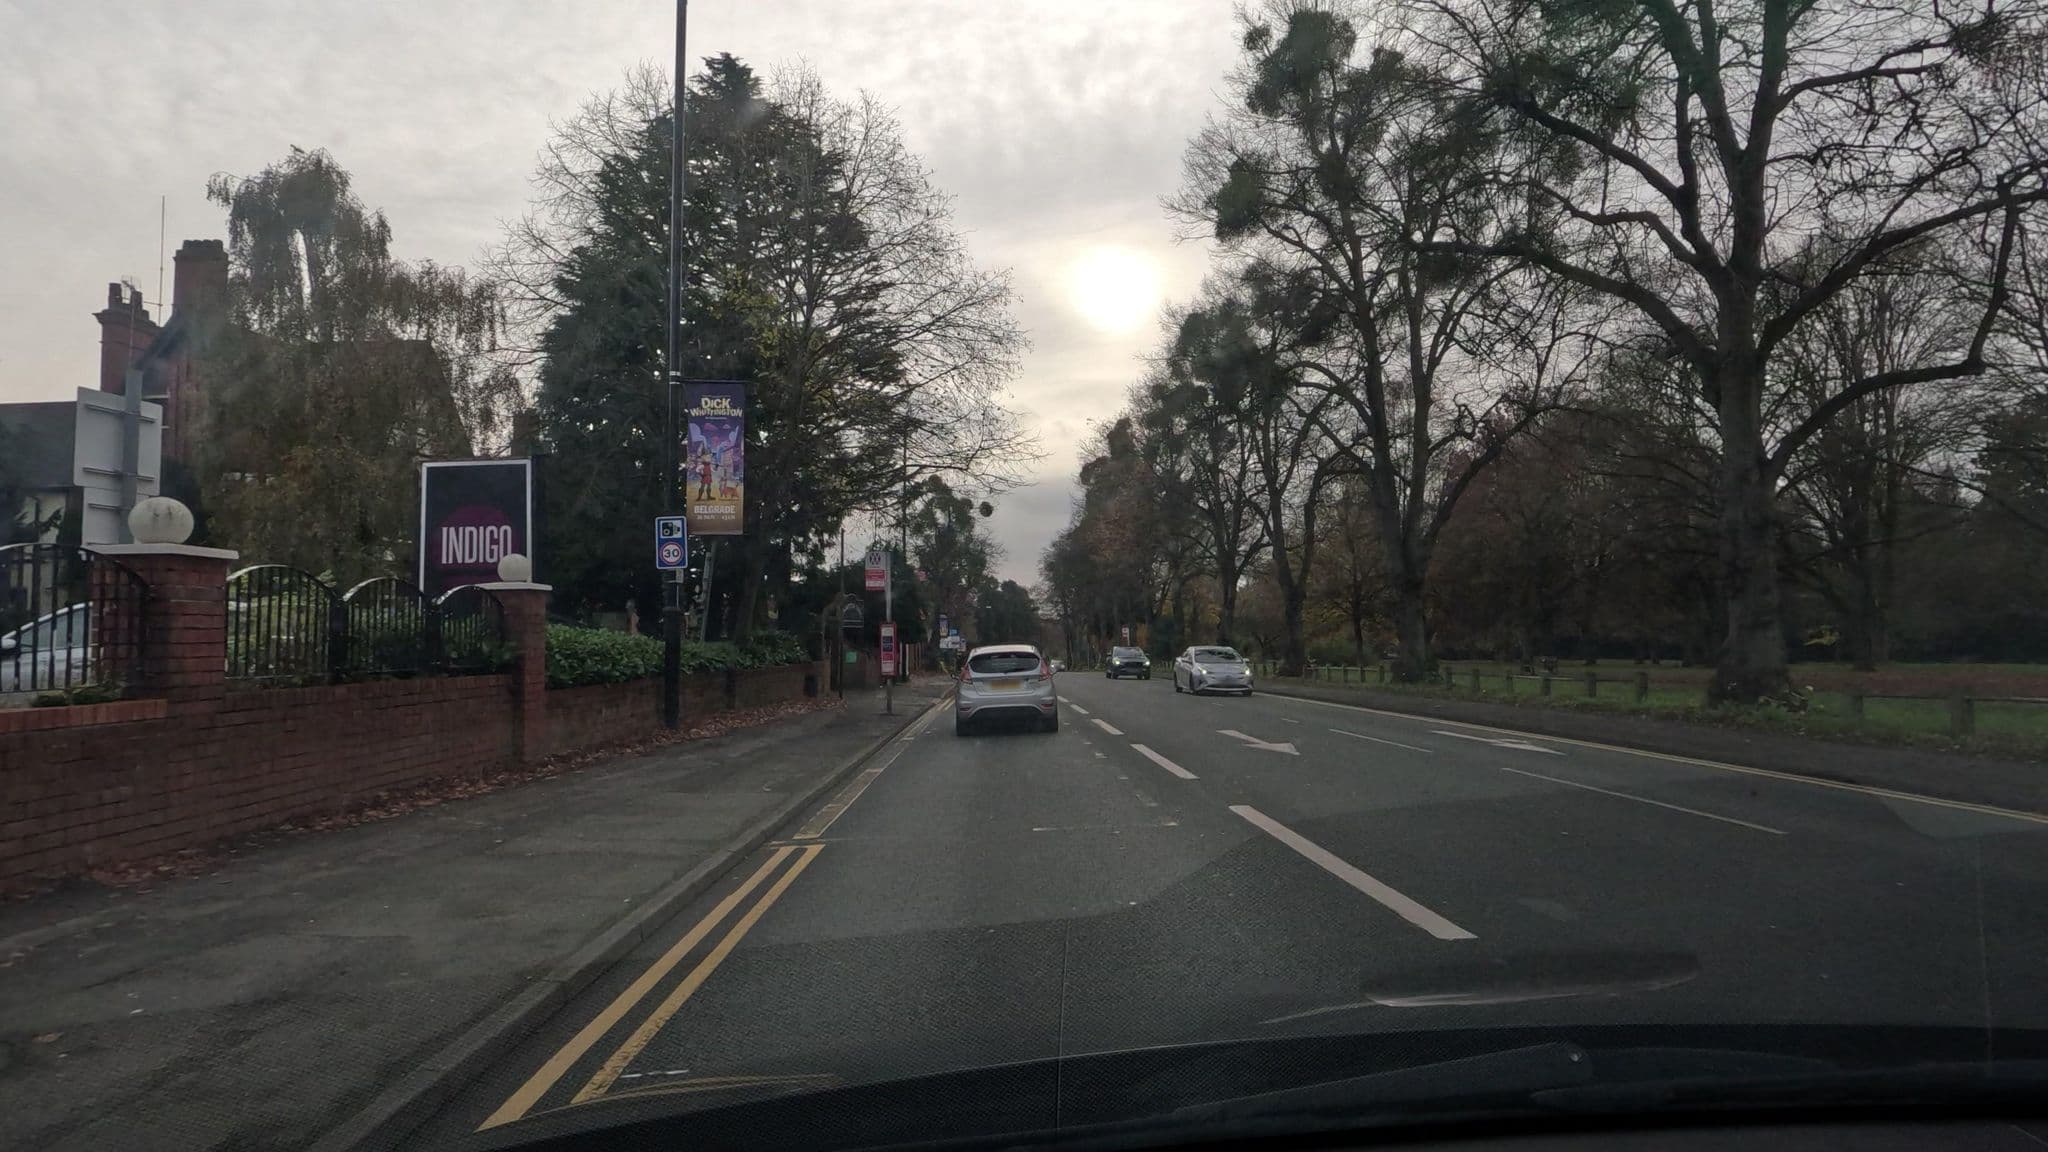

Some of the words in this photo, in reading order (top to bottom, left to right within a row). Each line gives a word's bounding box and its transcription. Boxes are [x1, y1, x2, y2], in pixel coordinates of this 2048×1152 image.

[694, 505, 736, 514] BELGRADE
[441, 525, 512, 564] INDIGO
[663, 548, 680, 559] 30
